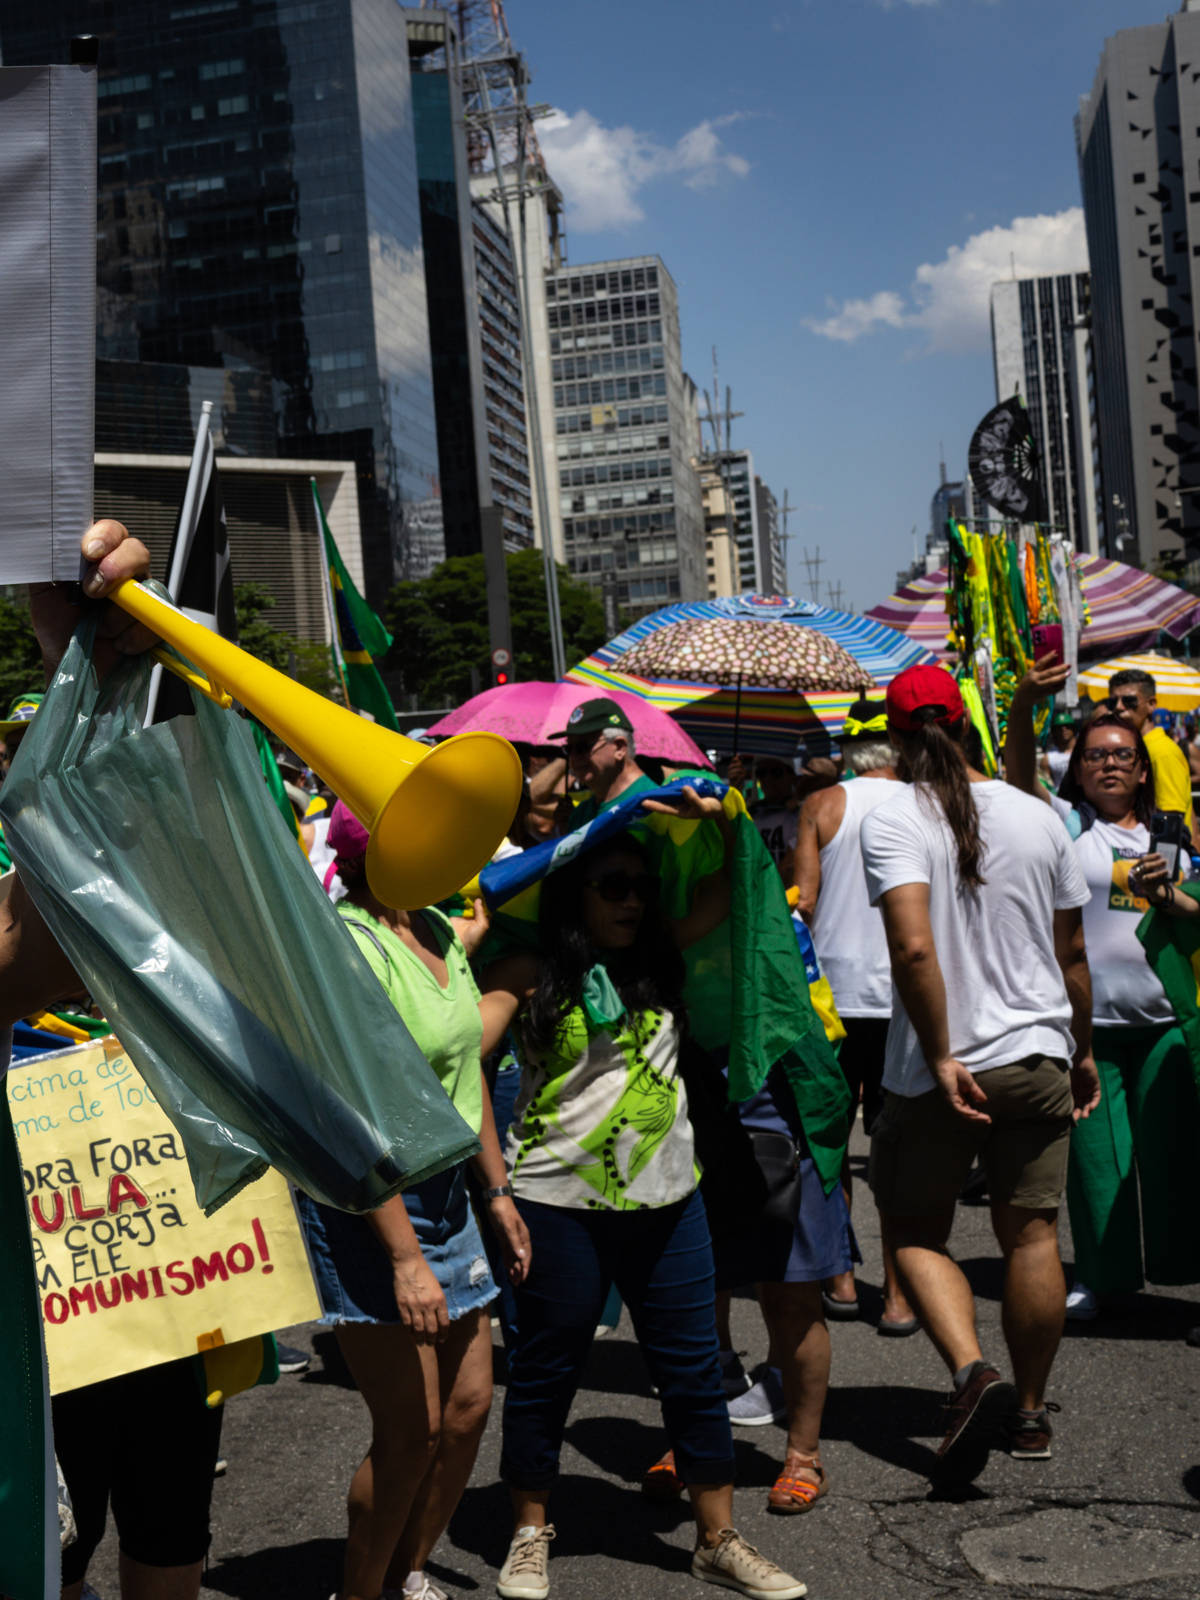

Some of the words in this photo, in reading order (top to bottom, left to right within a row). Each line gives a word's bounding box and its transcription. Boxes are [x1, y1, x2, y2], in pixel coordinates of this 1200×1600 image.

[8, 1068, 88, 1103] cima
[96, 1049, 128, 1079] de
[12, 1114, 60, 1138] ma
[68, 1091, 104, 1123] de
[30, 1172, 176, 1234] ULA...
[43, 1217, 274, 1325] OMUNISMO!
[71, 1241, 131, 1283] ELE
